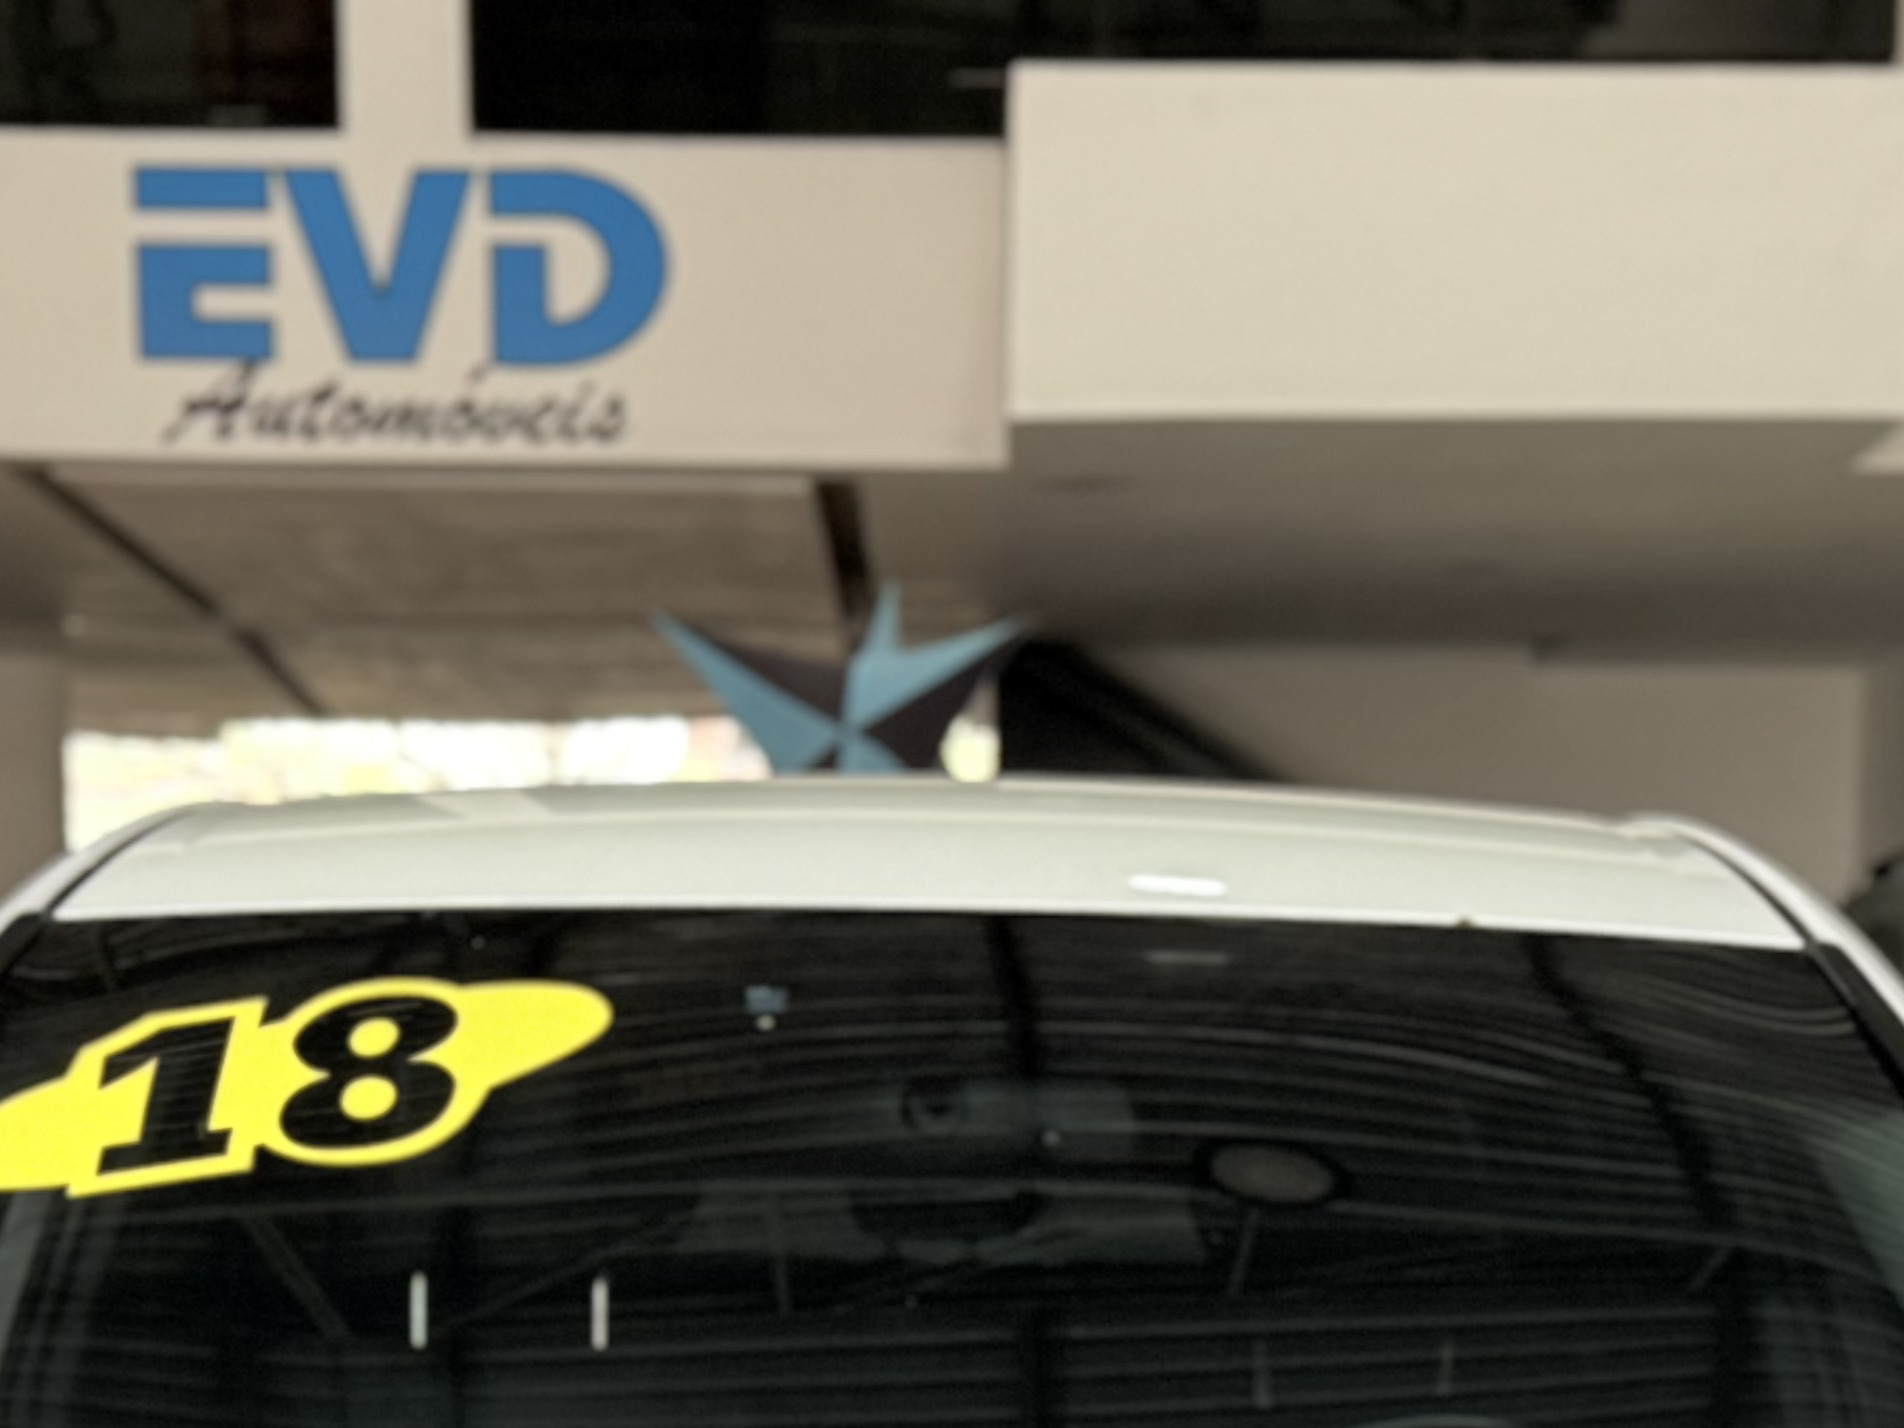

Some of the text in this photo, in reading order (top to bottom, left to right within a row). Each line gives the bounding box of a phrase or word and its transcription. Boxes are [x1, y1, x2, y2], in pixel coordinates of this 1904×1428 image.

[132, 166, 669, 367] EVD
[159, 356, 628, 447] Automóveis
[95, 995, 459, 1177] 18
